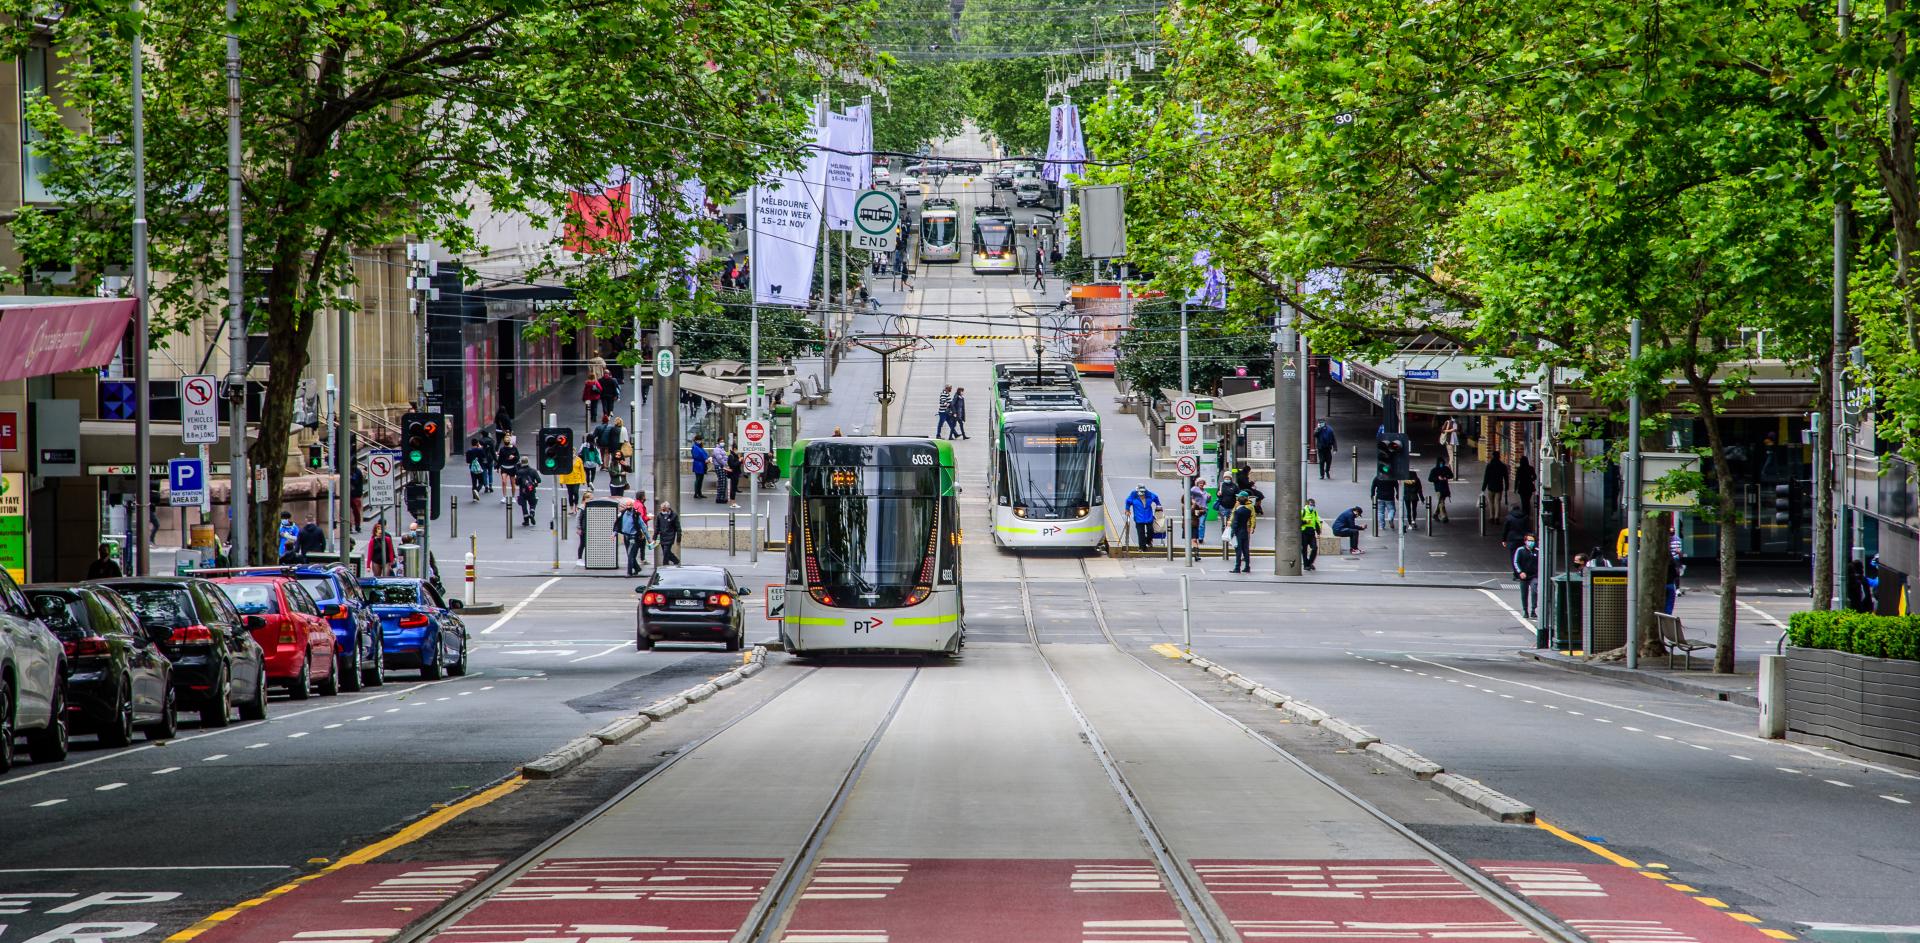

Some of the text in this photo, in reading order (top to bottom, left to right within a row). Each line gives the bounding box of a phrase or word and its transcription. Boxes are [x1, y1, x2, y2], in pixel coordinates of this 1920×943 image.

[1335, 113, 1353, 124] 30
[761, 196, 809, 209] MELBOURNE
[756, 206, 812, 220] FASHION WEEK
[789, 219, 805, 229] NOV
[859, 236, 888, 248] END
[1450, 388, 1530, 411] OPTUS
[1180, 405, 1191, 416] 10
[1077, 424, 1096, 433] 6074
[911, 454, 934, 466] 6033
[177, 466, 195, 487] P
[5, 496, 20, 505] FAYE
